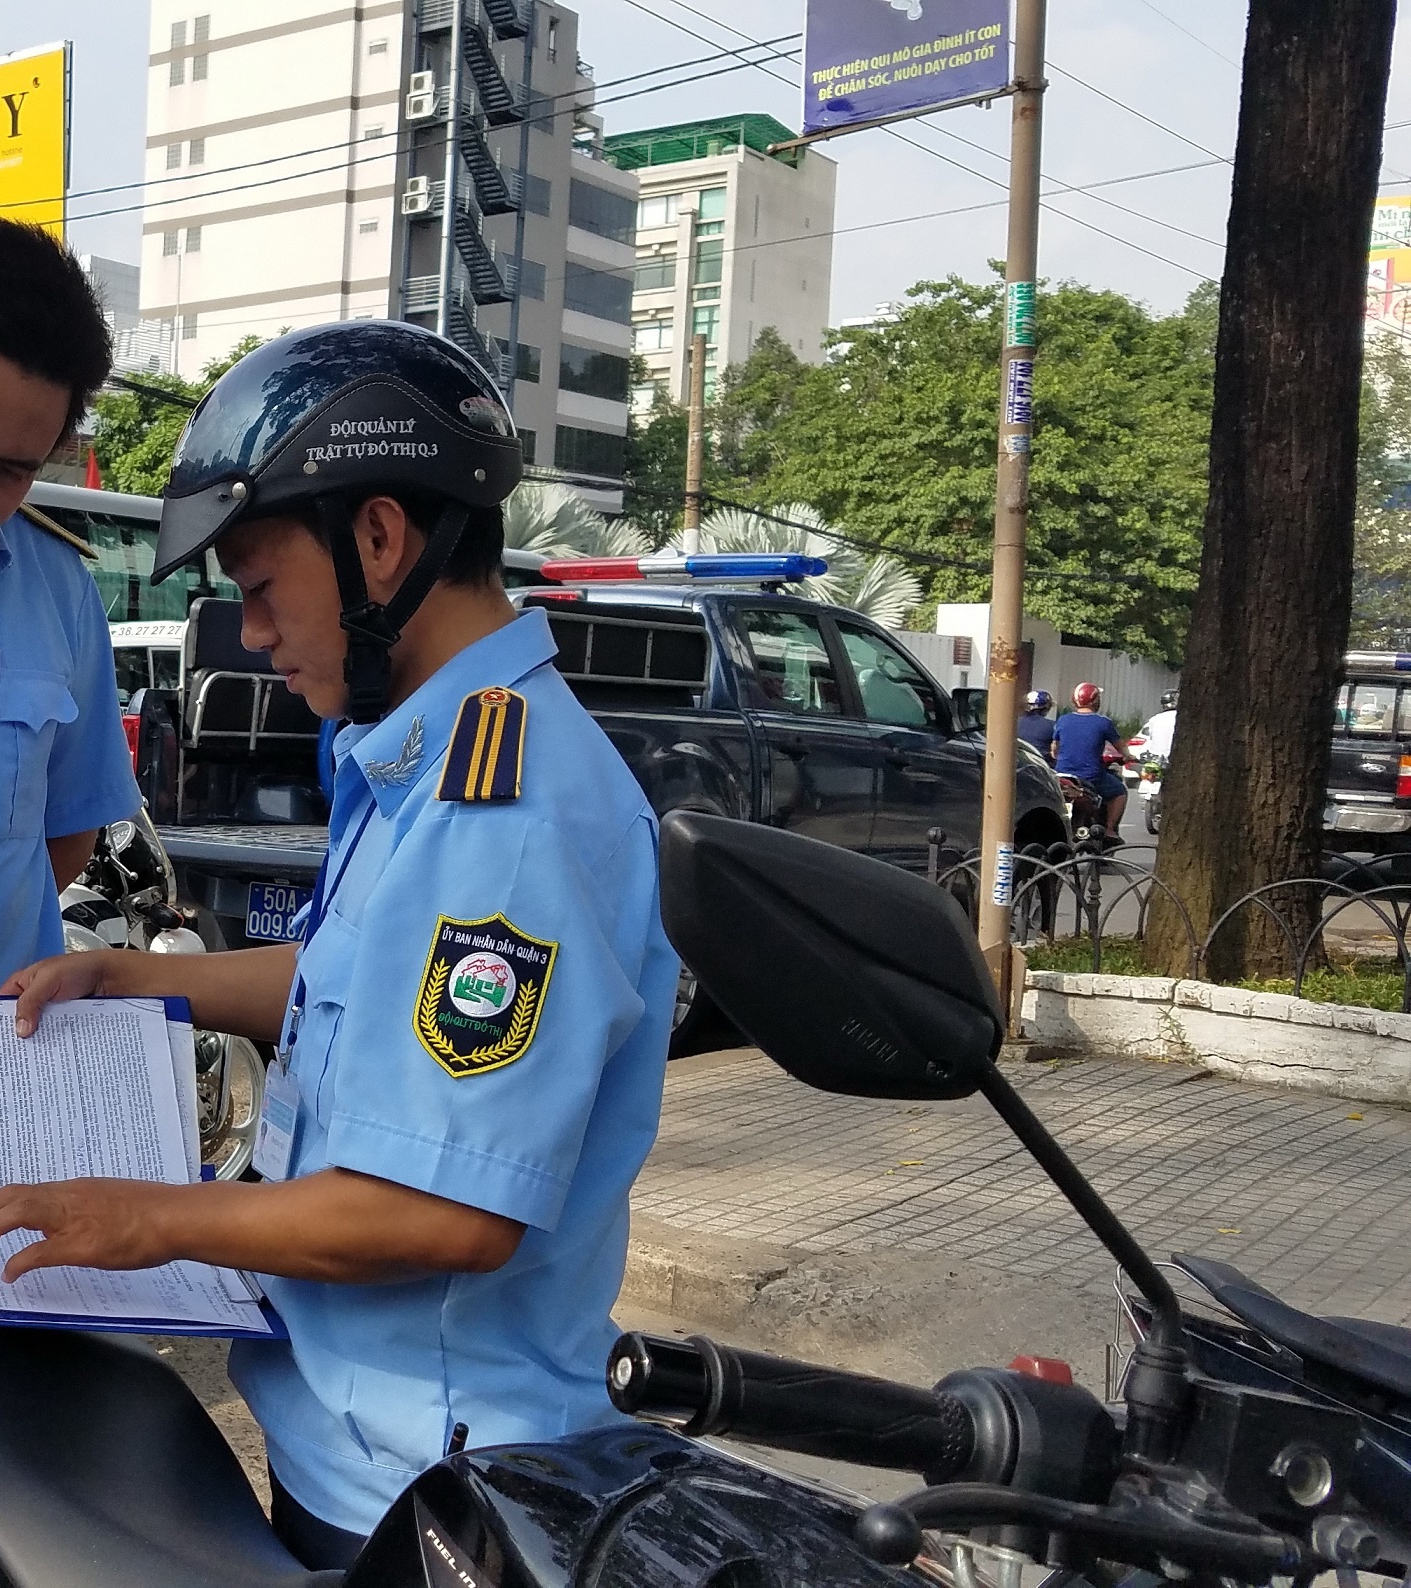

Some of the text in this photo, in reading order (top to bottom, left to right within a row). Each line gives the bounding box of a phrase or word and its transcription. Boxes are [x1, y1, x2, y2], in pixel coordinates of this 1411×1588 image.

[842, 59, 869, 76] HIỆN
[870, 54, 890, 70] QUI
[892, 46, 911, 65] MÔ
[913, 45, 932, 59] GIA
[933, 34, 963, 52] ĐÌNH
[965, 29, 976, 45] ÍT
[977, 23, 1002, 40] CON
[894, 64, 922, 80] NUÔI
[924, 59, 946, 76] DẠY
[948, 51, 972, 68] CHO
[974, 43, 996, 61] TỐT
[330, 416, 416, 438] ĐỘI QUẢN LÝ
[306, 440, 438, 462] TRẬT TỰ ĐÔ THỊ Q.3
[264, 886, 296, 914] 50A
[442, 925, 548, 964] ỦY BAN NHÂN DÂN QUẬN 3
[426, 1528, 457, 1571] FUEL
